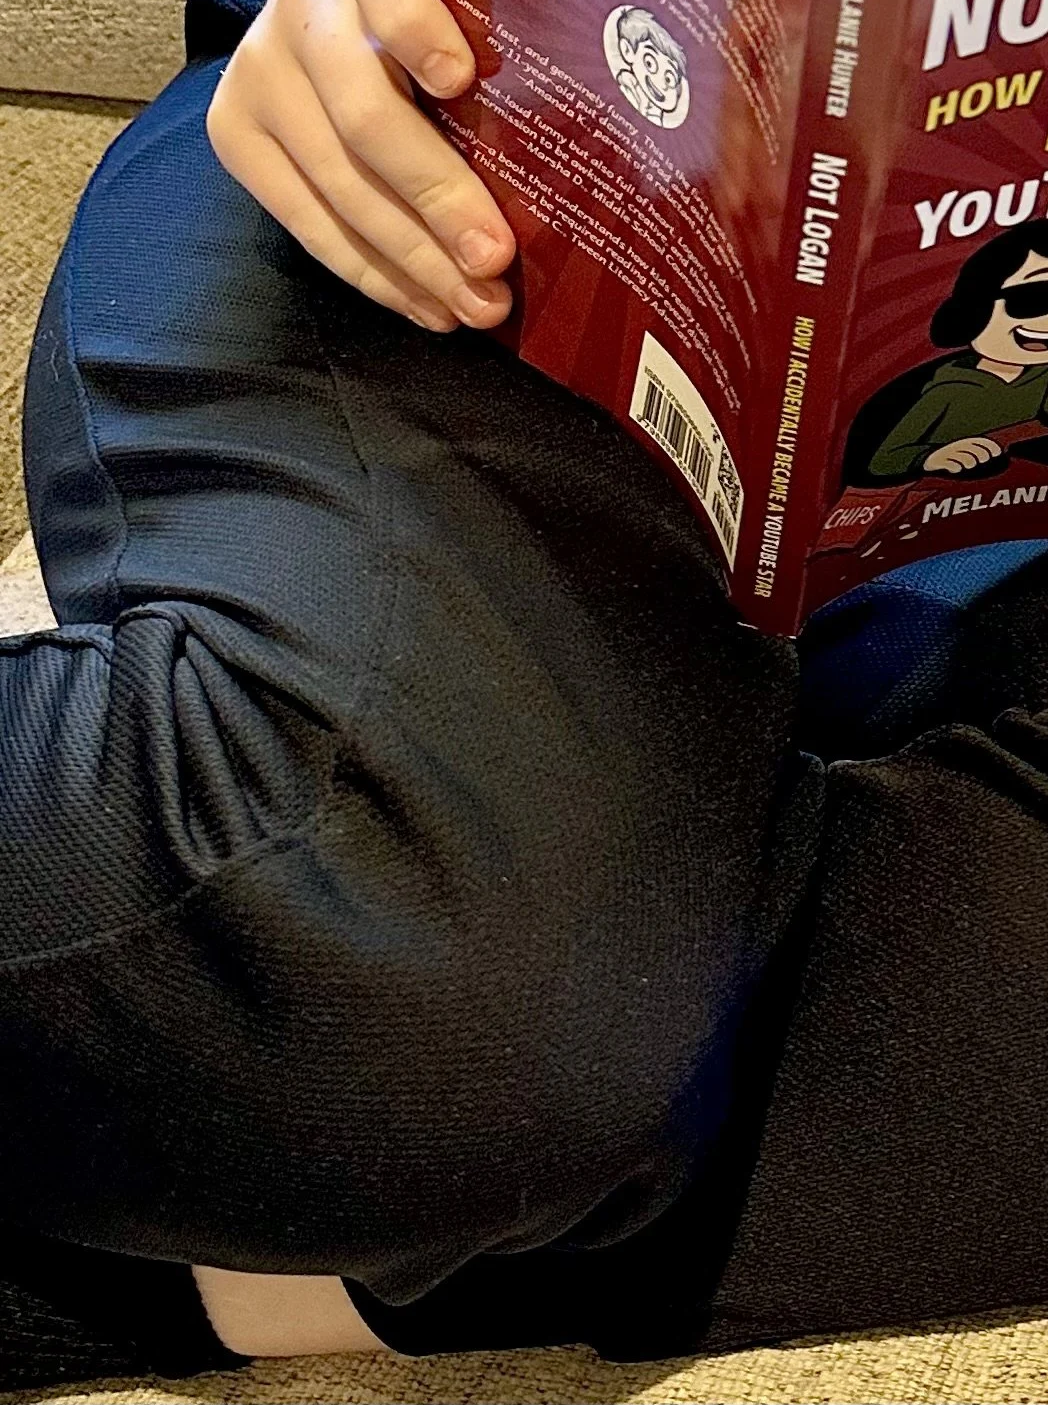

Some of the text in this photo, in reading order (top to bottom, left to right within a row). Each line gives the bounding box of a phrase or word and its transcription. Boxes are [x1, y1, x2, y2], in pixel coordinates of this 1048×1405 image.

[486, 36, 505, 53] my
[506, 48, 576, 102] 11-year-old
[575, 99, 597, 119] put
[598, 117, 631, 145] down
[630, 140, 651, 165] his
[671, 183, 691, 205] and
[690, 205, 705, 225] ask
[524, 46, 550, 67] and
[549, 65, 606, 109] genuinely
[644, 134, 664, 161] This
[664, 156, 674, 171] is
[708, 212, 727, 243] book
[824, 49, 860, 118] HUNTER
[924, 69, 1042, 132] HOW
[474, 92, 538, 140] permission
[539, 136, 553, 150] to
[554, 148, 569, 177] be
[670, 246, 690, 268] and
[497, 151, 526, 178] book
[528, 174, 553, 196] that
[554, 193, 626, 250] understands
[626, 246, 650, 270] how
[649, 267, 670, 293] kids
[533, 114, 571, 148] funny
[568, 139, 589, 160] but
[590, 158, 615, 179] also
[615, 175, 638, 200] full
[635, 194, 650, 207] of
[592, 129, 632, 163] parent
[633, 160, 647, 174] of
[644, 165, 654, 182] a
[654, 181, 698, 234] reluctant
[795, 152, 849, 285] NOT LOGAN
[473, 149, 497, 172] This
[498, 169, 539, 200] should
[539, 195, 555, 212] be
[556, 209, 605, 247] required
[605, 247, 647, 285] reading
[663, 299, 688, 328] every
[591, 188, 633, 227] Middle
[631, 220, 668, 261] School
[571, 232, 610, 268] Tween
[608, 261, 653, 307] Literacy
[648, 297, 692, 349] Advocate
[754, 316, 815, 598] HOW I ACCIDENTALLY BECAME A YOUTUBE STAR
[823, 505, 882, 530] CHIPS
